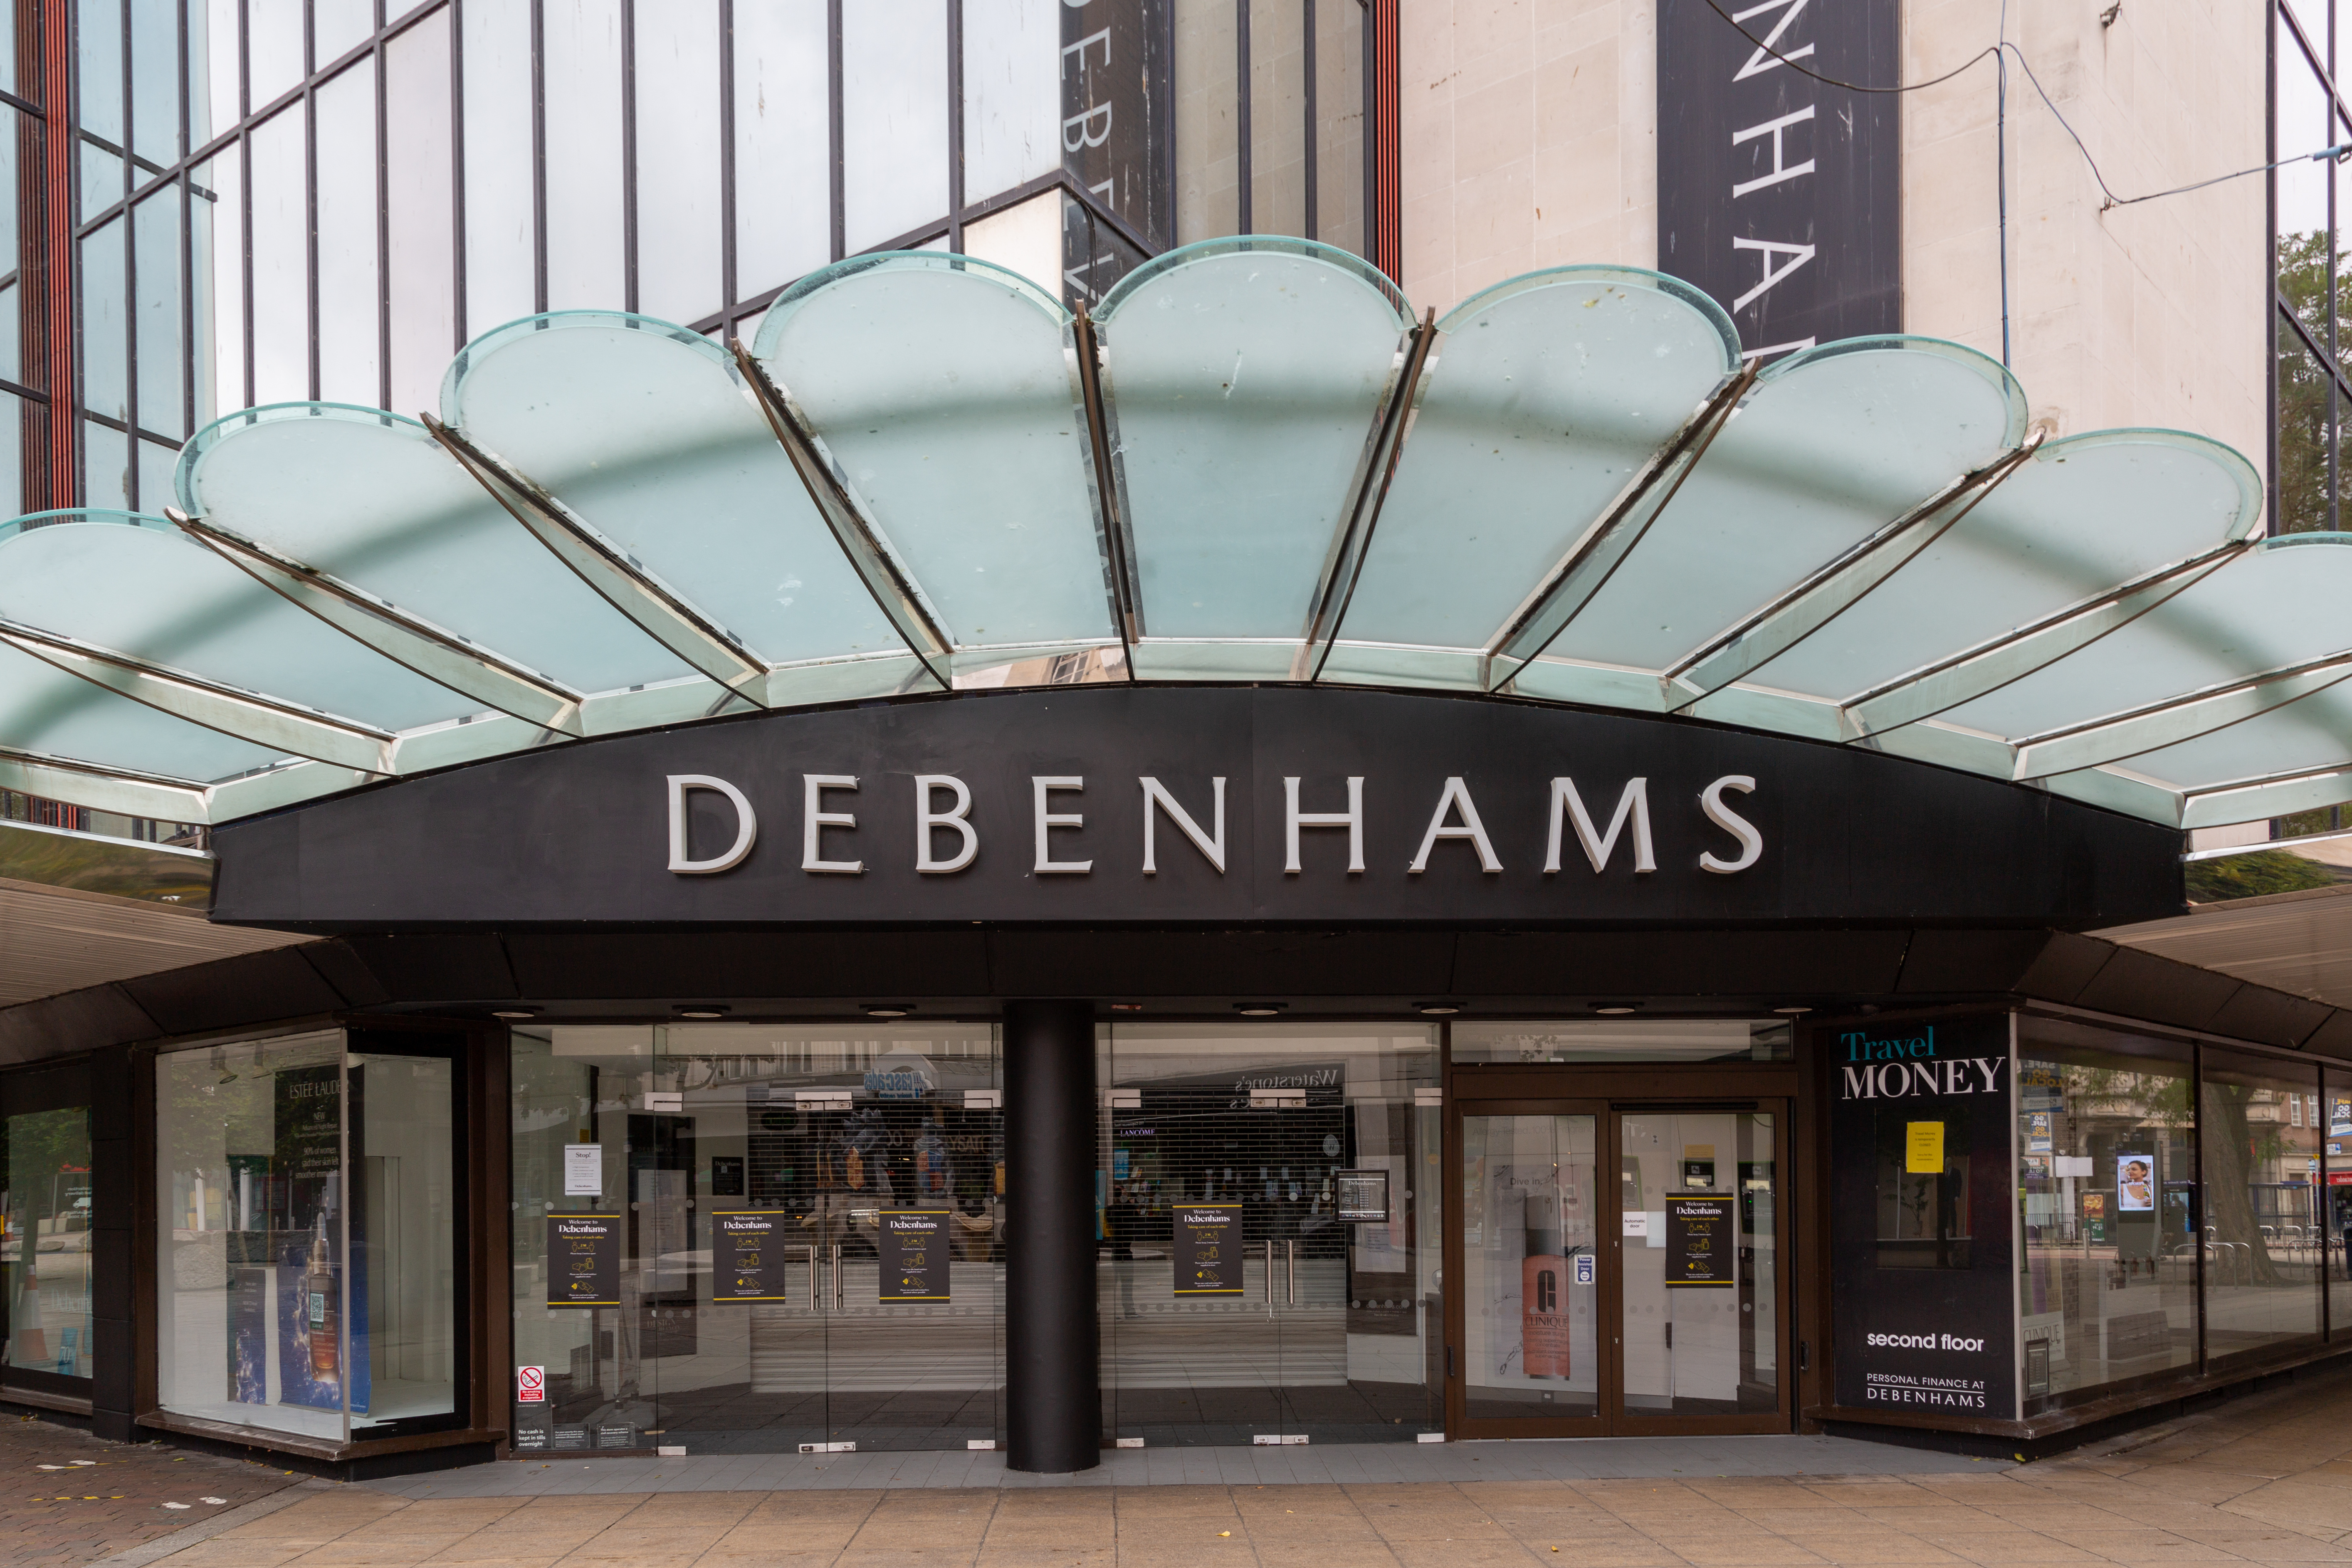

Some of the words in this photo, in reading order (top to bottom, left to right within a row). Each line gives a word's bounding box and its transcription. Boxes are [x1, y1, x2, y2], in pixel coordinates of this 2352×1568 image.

[667, 774, 1763, 876] DEBENHAMS
[1841, 1026, 1936, 1061] Travel
[1841, 1057, 2006, 1099] MONEY
[314, 1111, 326, 1120] NEW
[1472, 1127, 1500, 1137] Allergy
[1525, 1316, 1568, 1329] CLINIQUE
[1867, 1332, 1936, 1349] second
[1941, 1333, 1984, 1352] floor
[1867, 1373, 1918, 1385] PERSONAL
[1922, 1377, 1968, 1388] FINANCE
[1972, 1380, 1985, 1390] AT
[1867, 1388, 1985, 1408] DEBENHAMS
